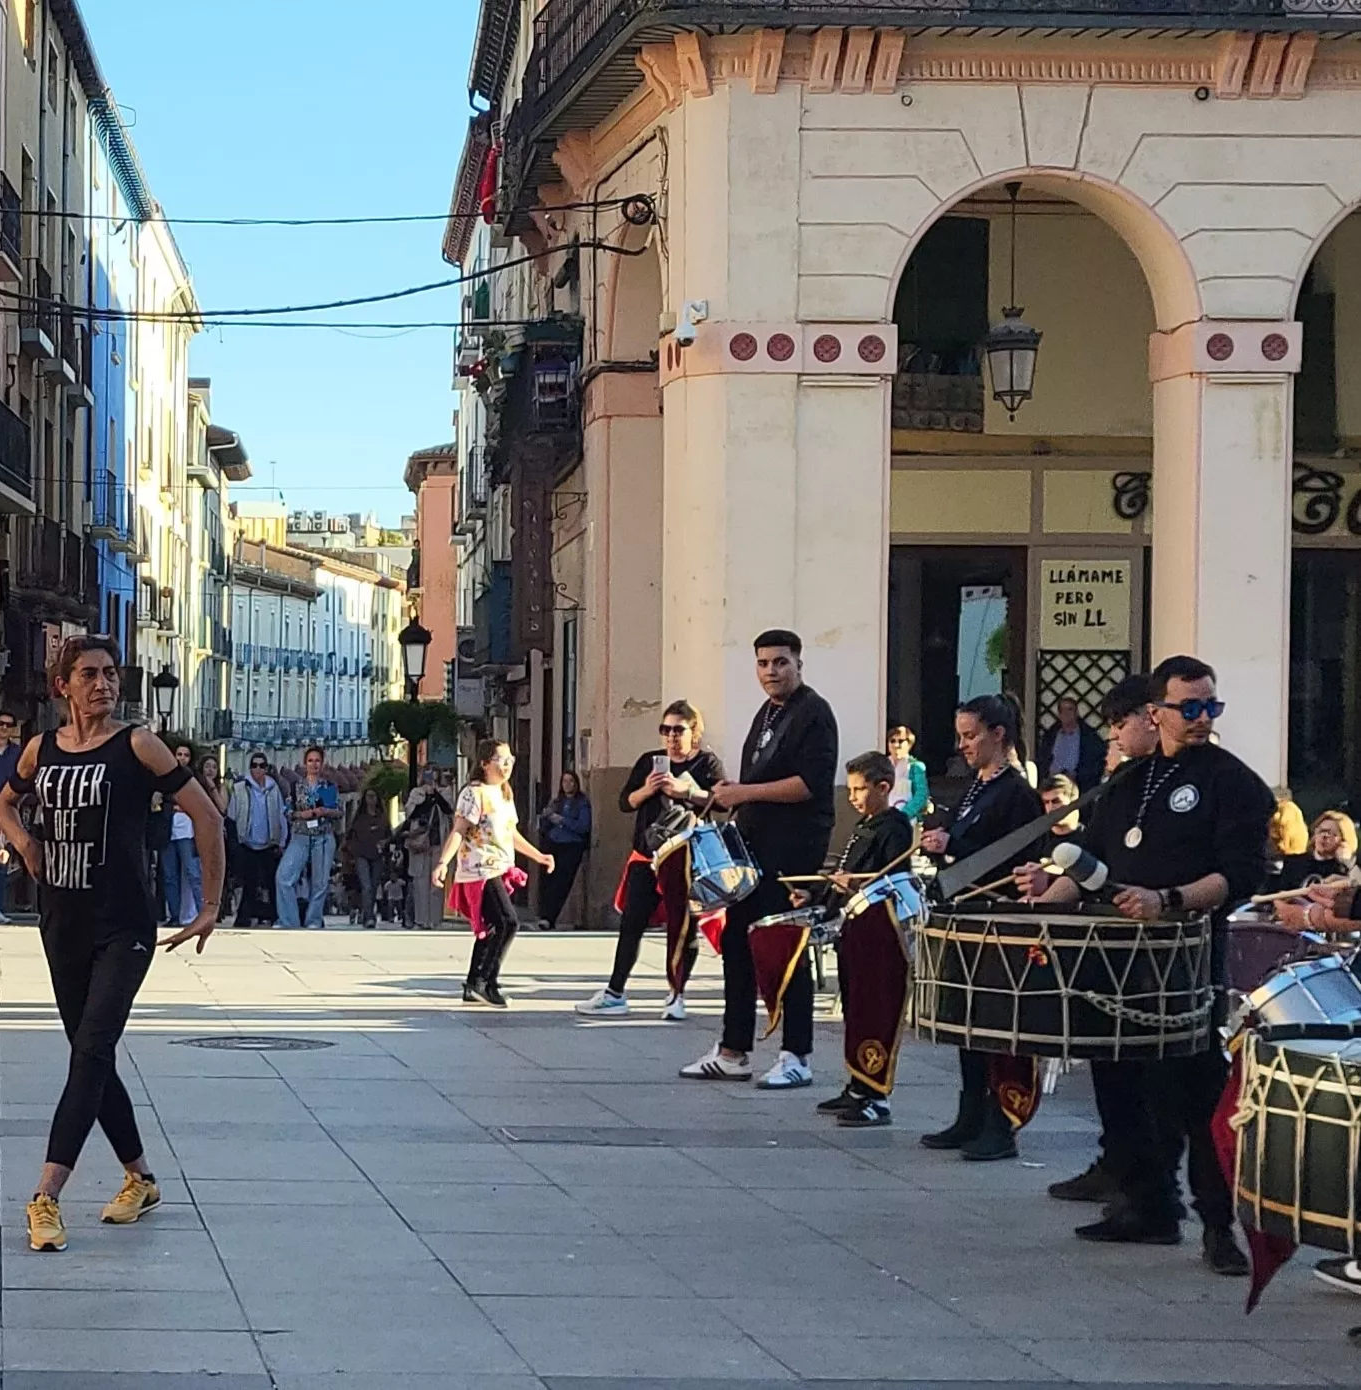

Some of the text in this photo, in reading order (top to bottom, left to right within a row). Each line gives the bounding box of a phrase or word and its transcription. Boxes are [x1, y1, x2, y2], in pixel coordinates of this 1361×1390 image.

[1049, 564, 1124, 584] LLÁMAME
[1055, 591, 1094, 605] PERO
[1053, 608, 1107, 627] SIN LL
[54, 808, 78, 841] OFF
